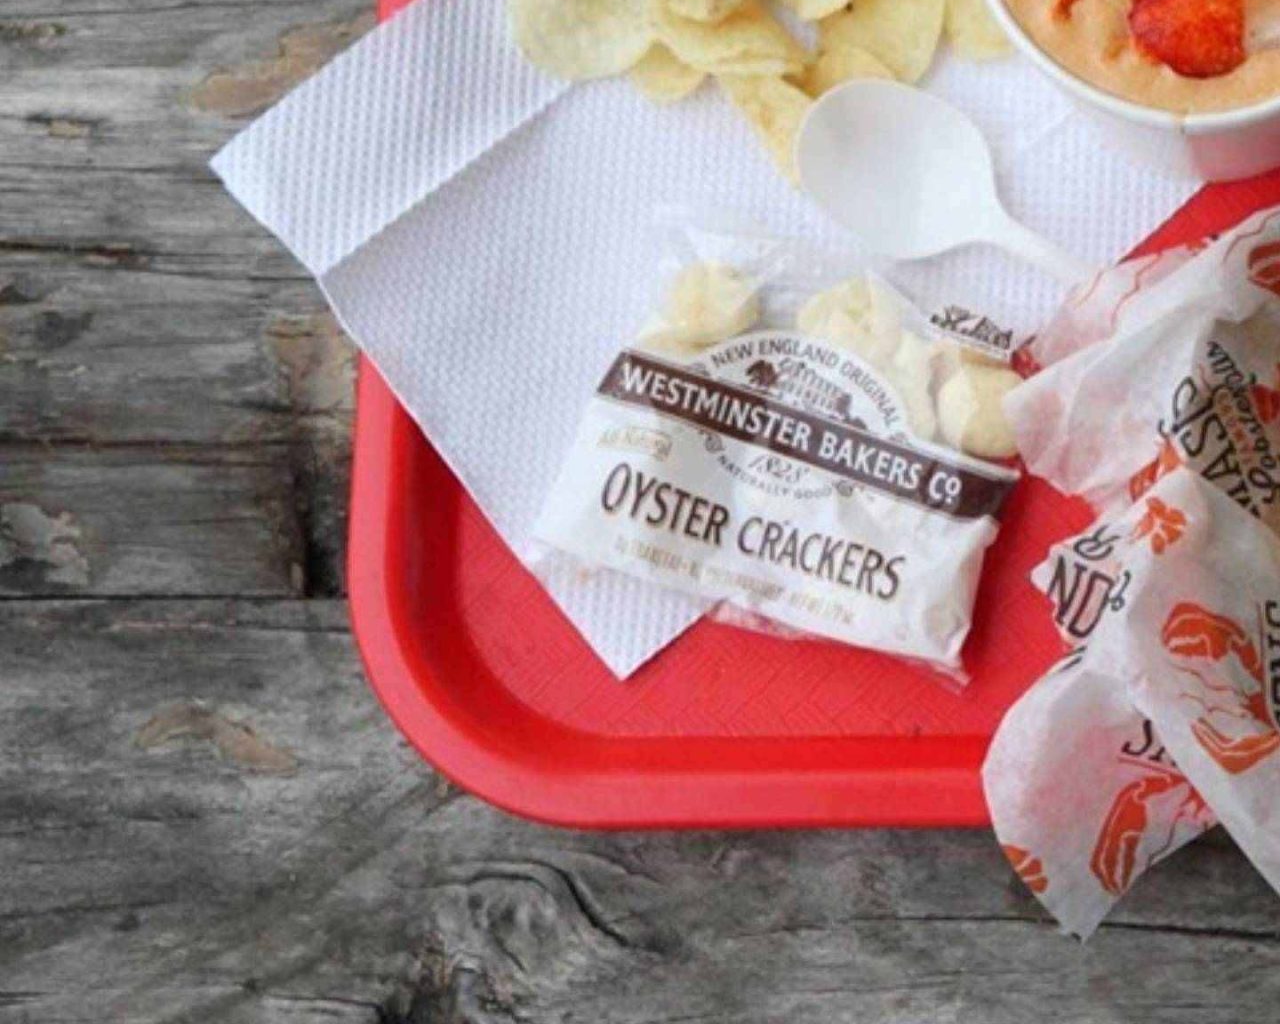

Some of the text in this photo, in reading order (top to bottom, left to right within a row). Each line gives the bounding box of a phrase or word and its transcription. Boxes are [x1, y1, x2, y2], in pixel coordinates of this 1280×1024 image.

[621, 361, 811, 452] WESTMINSTER
[817, 429, 925, 491] BAKERS
[710, 340, 754, 369] NEW
[757, 337, 841, 370] ENGLAND
[840, 359, 901, 427] ORIGINAL
[601, 462, 731, 546] OYSTER
[737, 516, 908, 602] CRACKERS
